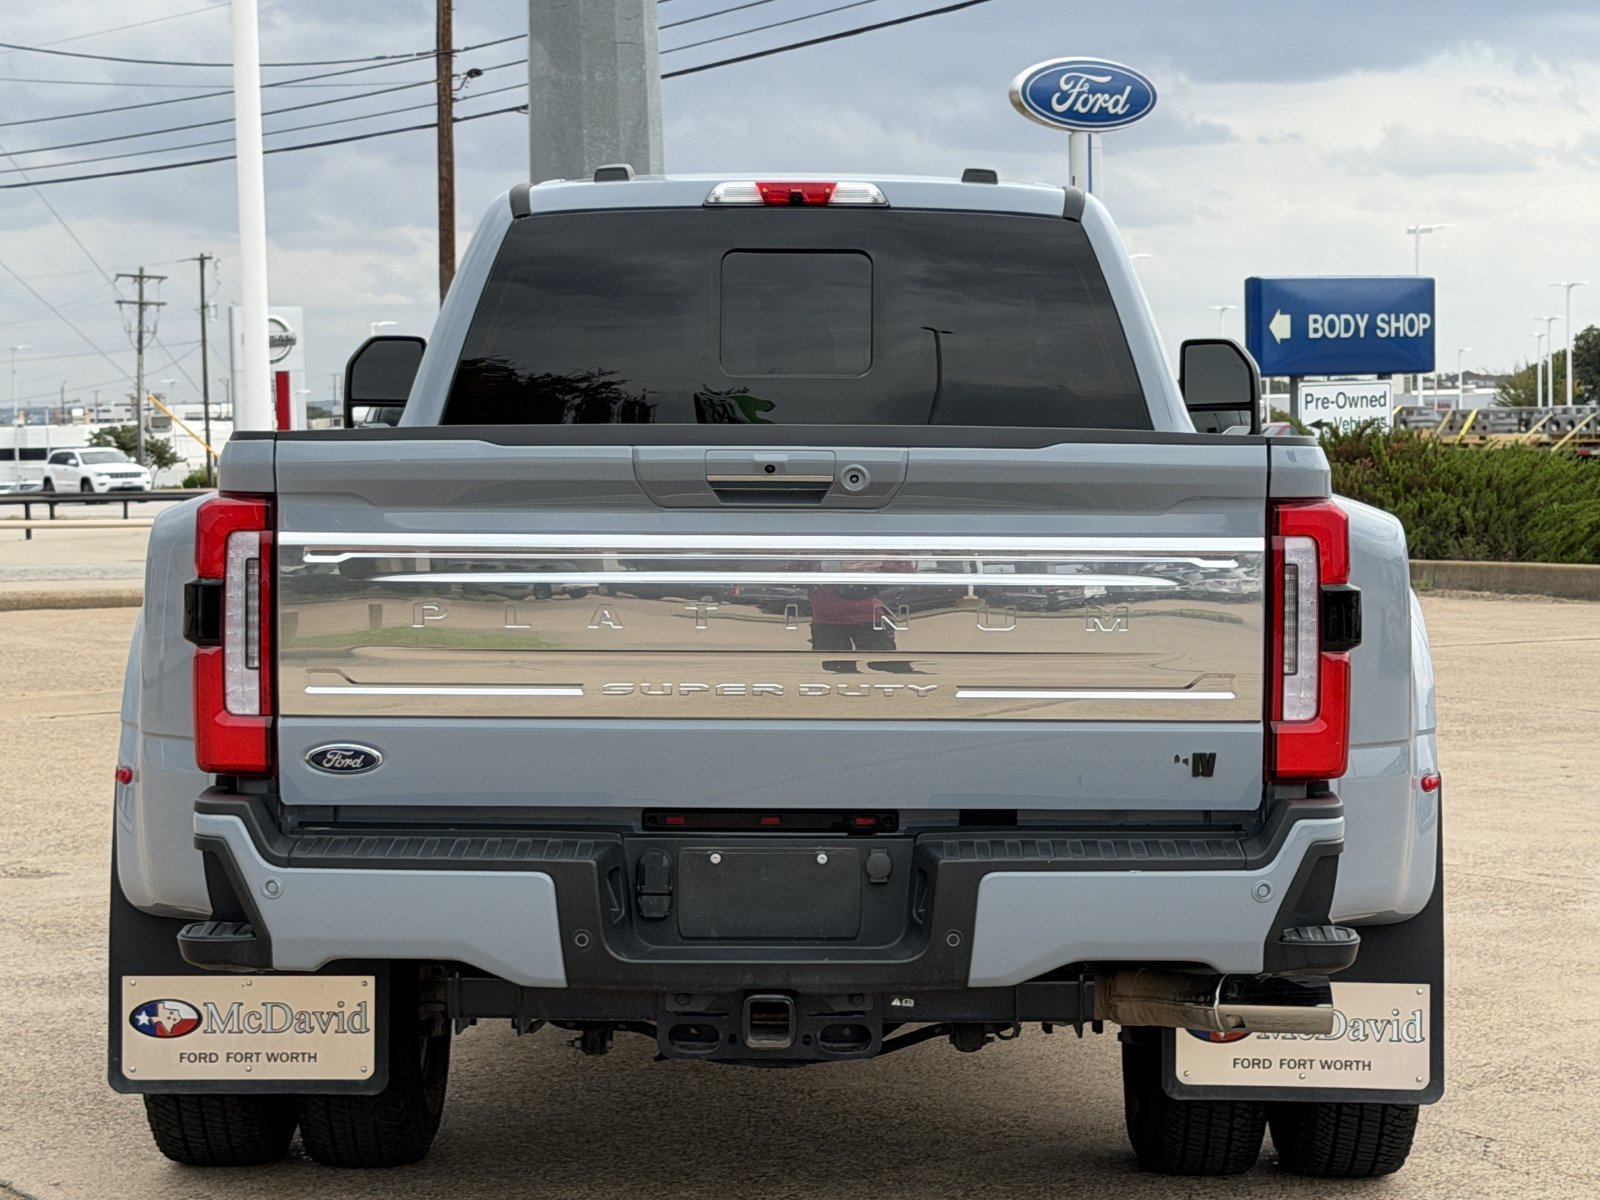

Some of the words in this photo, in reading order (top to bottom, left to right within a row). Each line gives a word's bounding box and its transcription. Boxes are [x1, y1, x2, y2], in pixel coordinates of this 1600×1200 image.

[1051, 72, 1132, 115] Ford
[1308, 313, 1369, 339] BODY
[1376, 312, 1431, 338] SHOP
[1304, 391, 1387, 410] Pre-Owned
[412, 602, 1128, 632] PLATINUM
[602, 682, 784, 697] SUPER
[799, 683, 938, 697] DUTY
[322, 749, 366, 768] Ford
[203, 1000, 370, 1035] McDavid
[1256, 1008, 1425, 1043] David
[179, 1052, 219, 1064] FORD
[226, 1051, 262, 1063] FORT
[265, 1051, 318, 1063] WORTH
[1232, 1057, 1273, 1069] FORD
[1279, 1058, 1316, 1070] FORT
[1319, 1059, 1372, 1071] WORTH
